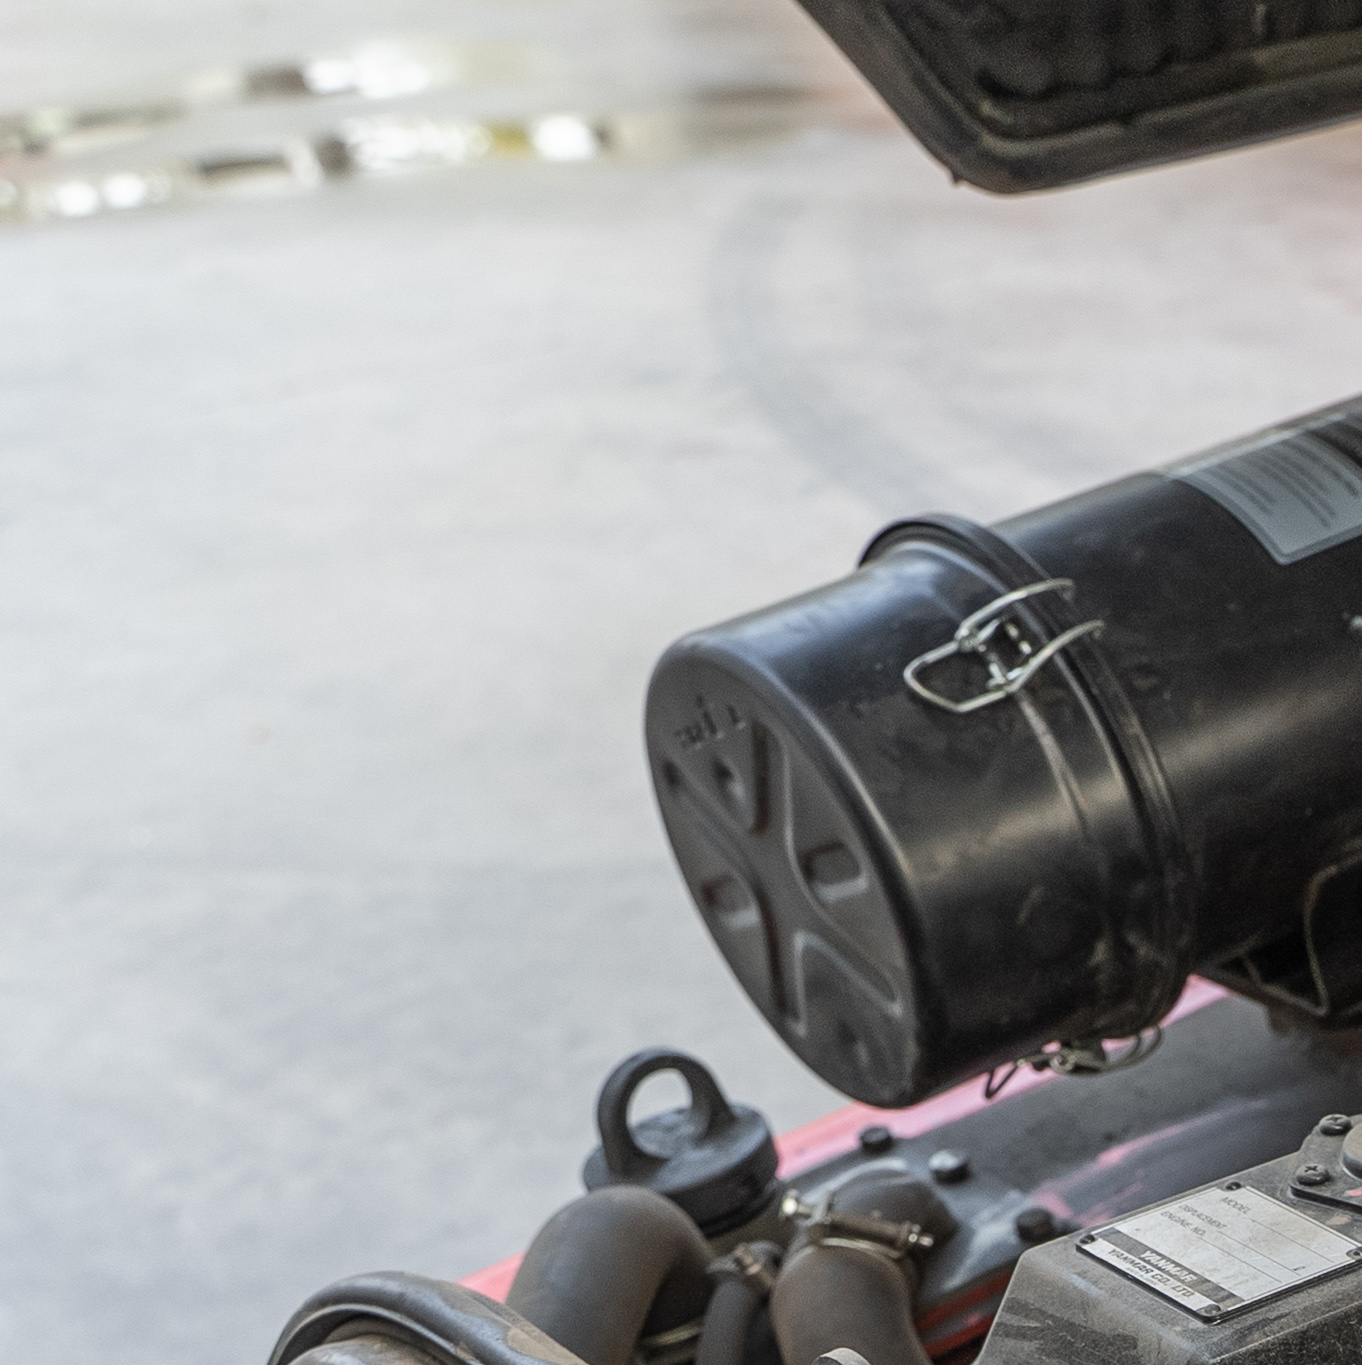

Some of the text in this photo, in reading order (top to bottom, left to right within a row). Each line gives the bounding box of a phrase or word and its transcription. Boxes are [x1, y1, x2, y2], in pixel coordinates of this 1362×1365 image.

[1221, 1196, 1252, 1215] MODEL
[1160, 1210, 1194, 1229] ENGINE
[1108, 1248, 1155, 1275] YANMAR
[1139, 1250, 1198, 1283] YANMAR
